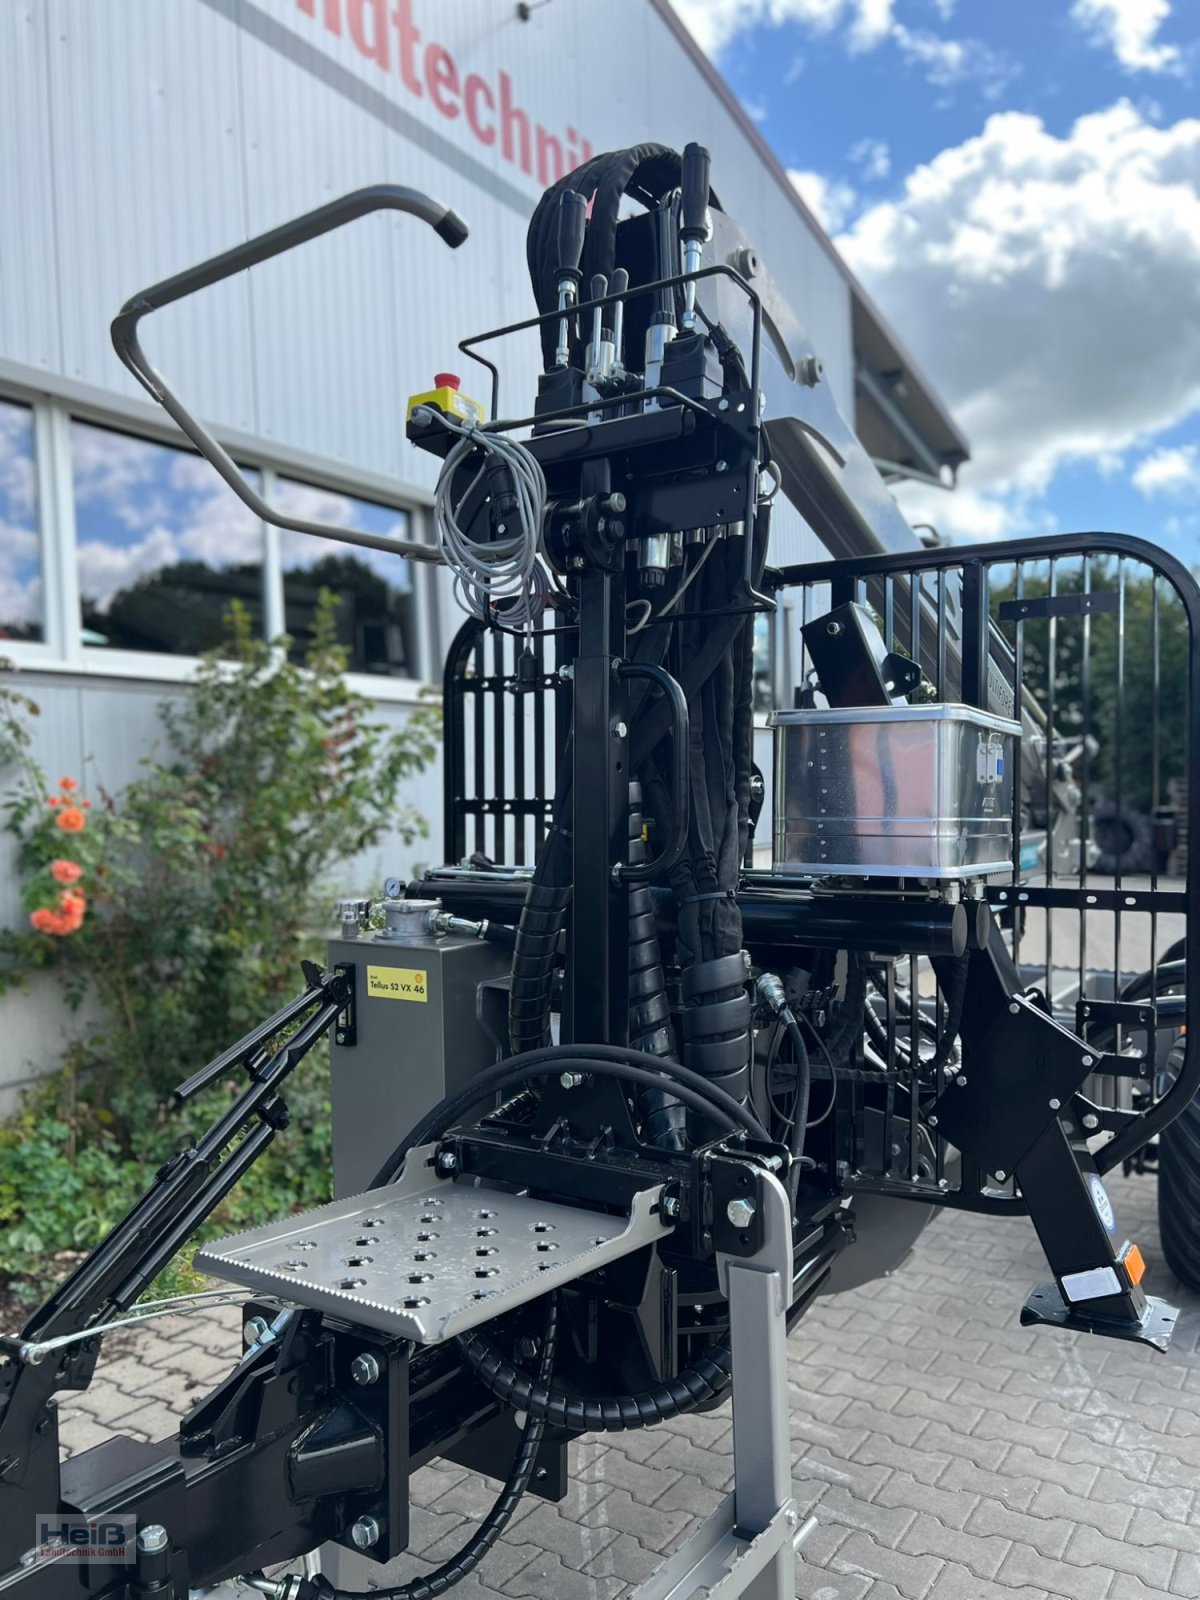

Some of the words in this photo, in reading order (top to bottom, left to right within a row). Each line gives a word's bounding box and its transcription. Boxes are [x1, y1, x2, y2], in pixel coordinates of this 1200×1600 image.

[295, 0, 594, 191] dtechni
[370, 981, 389, 990] Tellus
[391, 983, 399, 991] S2
[401, 984, 412, 992] VX
[414, 985, 425, 994] 46
